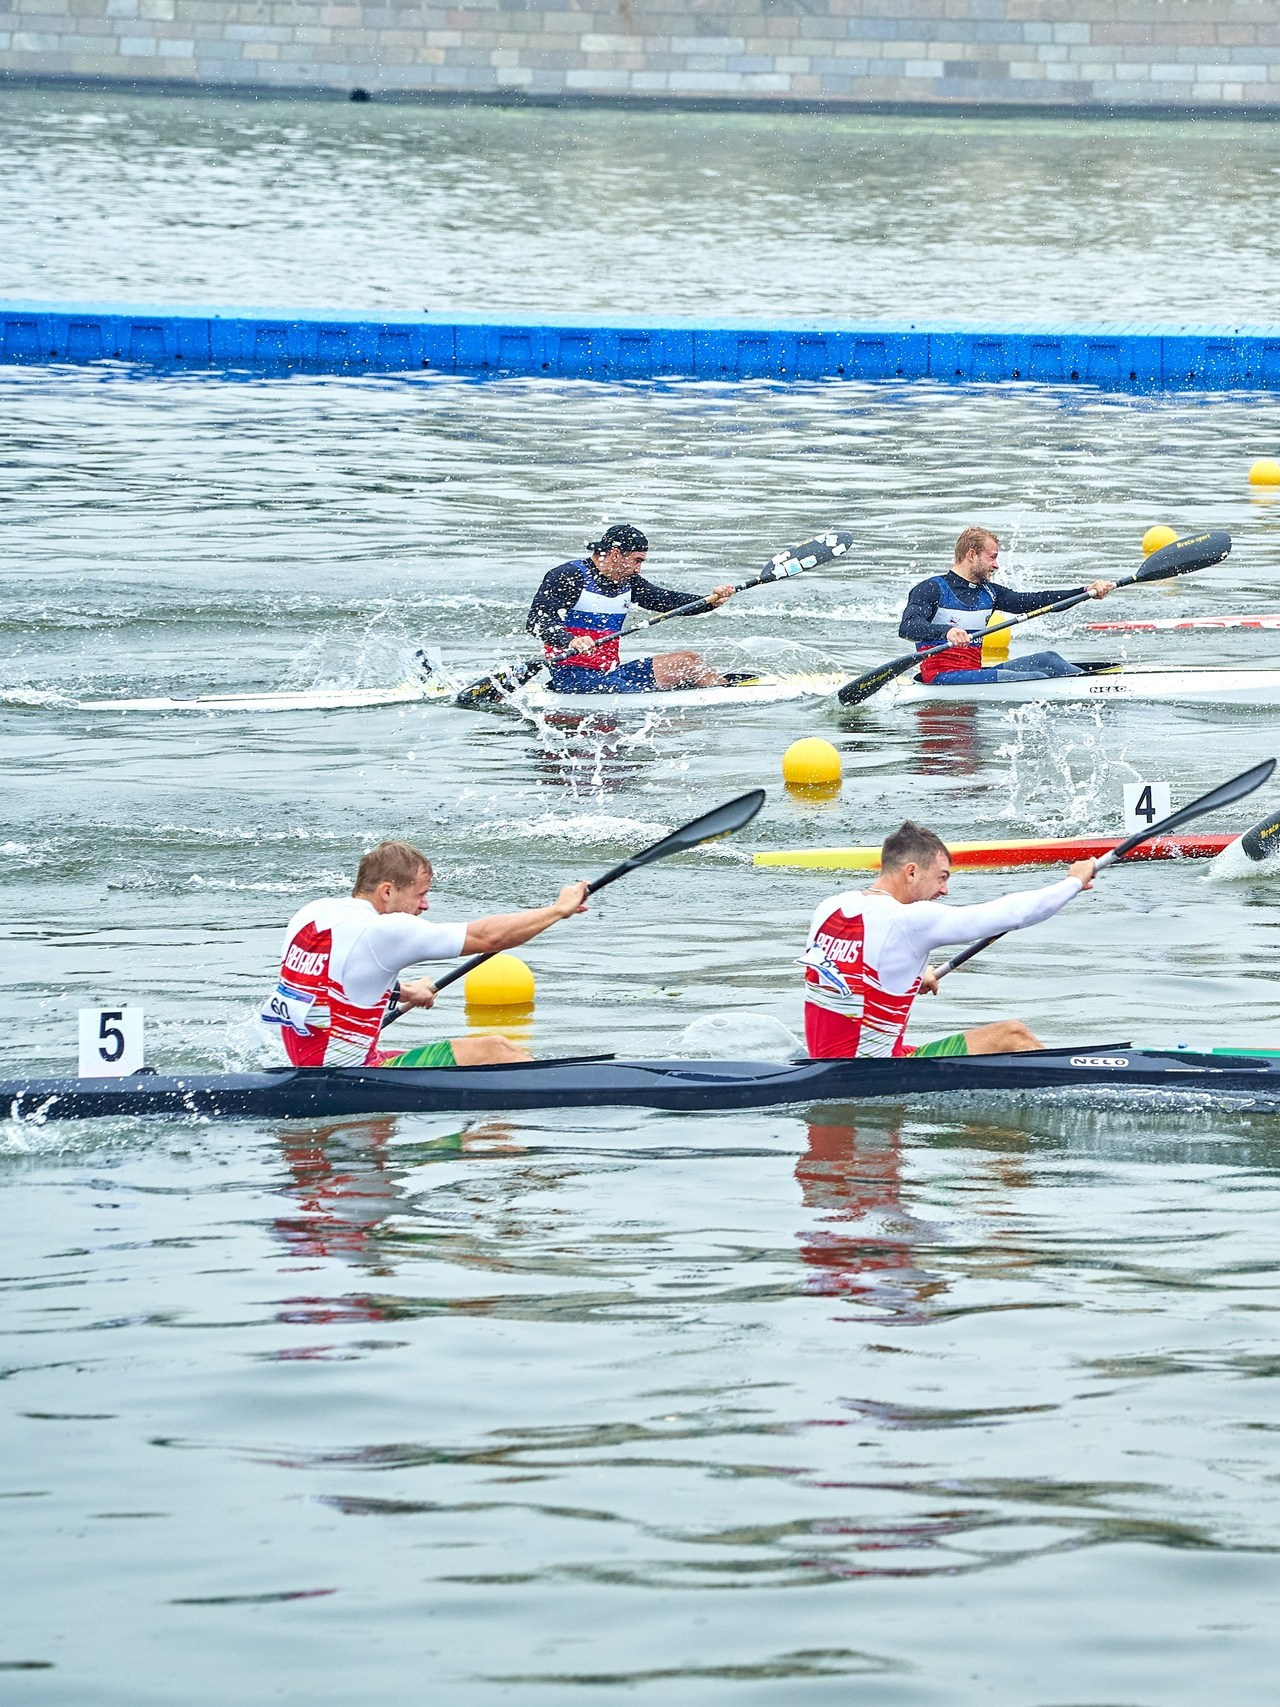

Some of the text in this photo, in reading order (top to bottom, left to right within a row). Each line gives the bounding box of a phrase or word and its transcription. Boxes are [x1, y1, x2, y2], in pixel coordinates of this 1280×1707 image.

[1135, 785, 1156, 824] 4
[285, 944, 328, 976] BELARUS
[270, 997, 291, 1020] 60
[98, 1011, 125, 1063] 5
